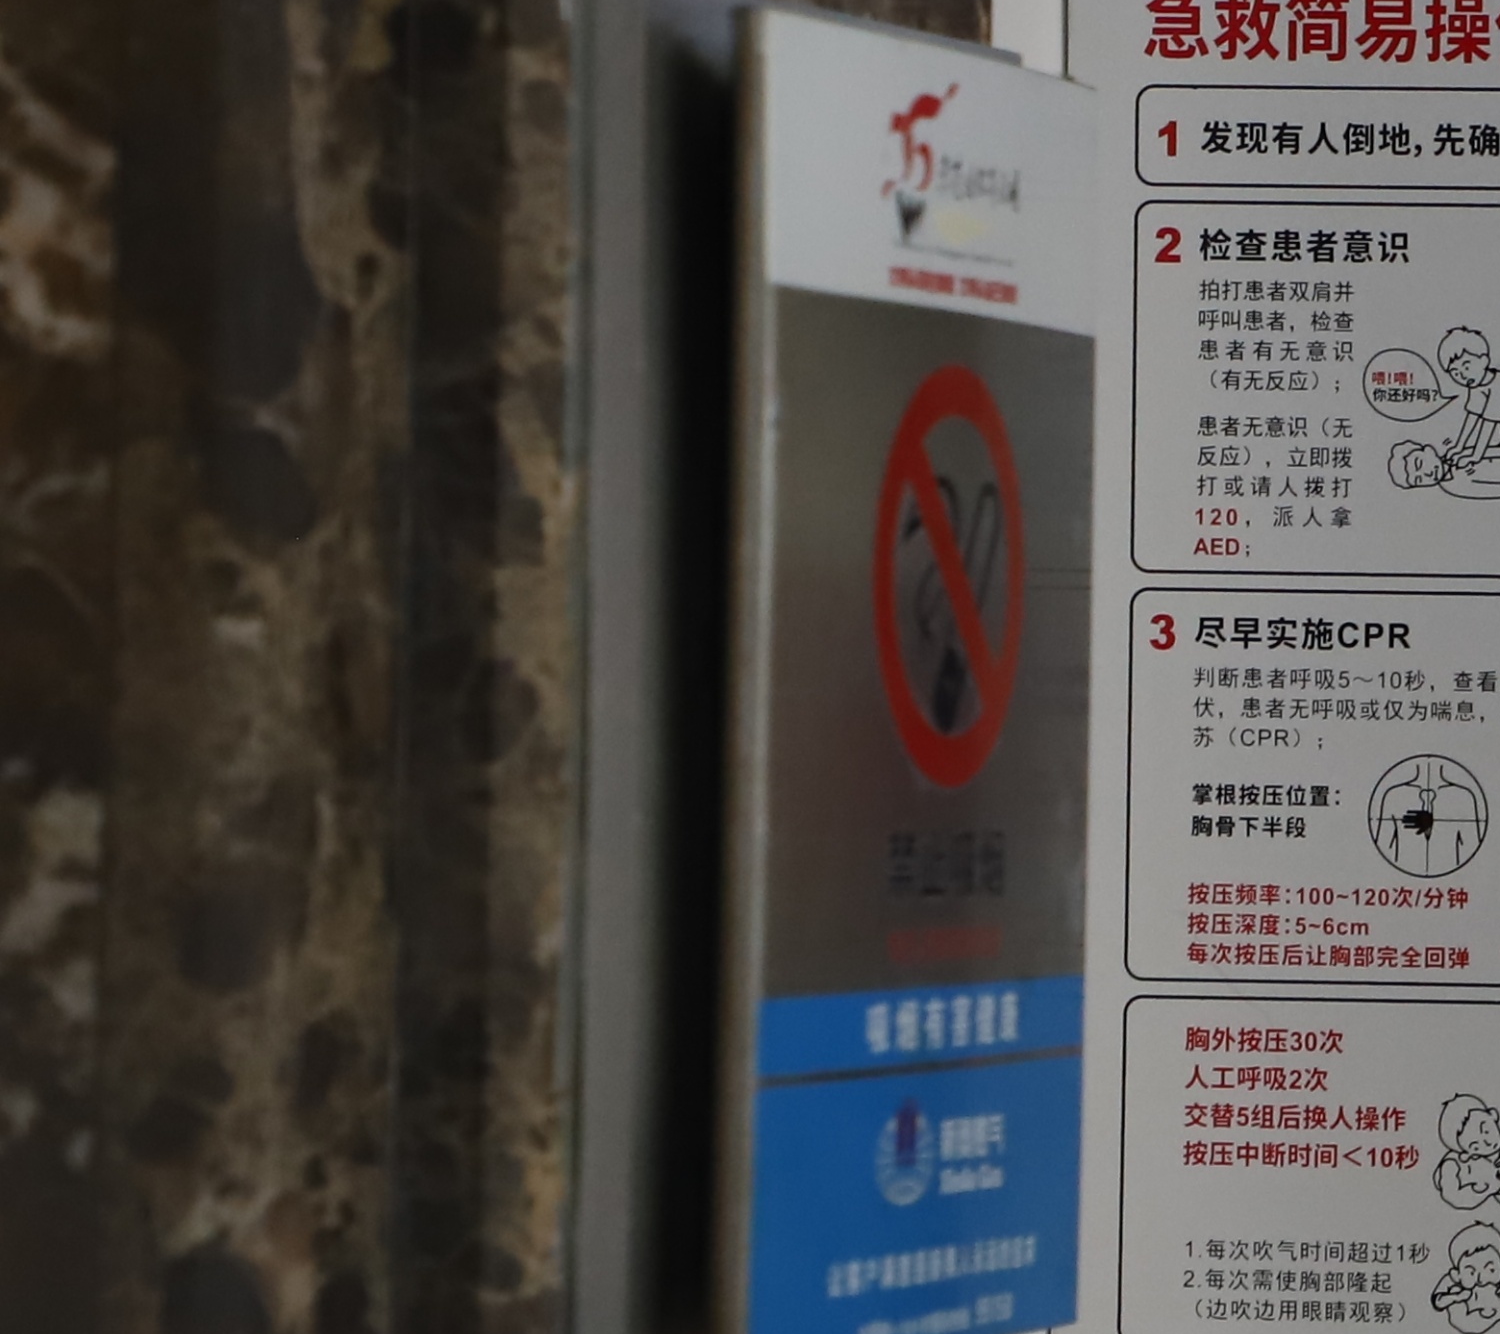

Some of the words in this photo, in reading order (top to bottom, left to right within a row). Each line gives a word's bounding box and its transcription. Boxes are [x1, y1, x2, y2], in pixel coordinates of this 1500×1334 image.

[1158, 121, 1177, 157] 1
[1155, 227, 1181, 263] 2
[1200, 228, 1409, 263] 检查患者意识
[1199, 279, 1354, 302] 拍打患者双肩并
[1198, 339, 1354, 362] 患者有无意识
[1197, 475, 1352, 498] 打或请人拨打
[1150, 614, 1176, 650] 3
[1195, 617, 1411, 651] 尽早实施CPR
[1191, 815, 1306, 838] 胸骨下半段
[1187, 942, 1470, 969] 每次按压后让胸部完全回弹
[1185, 1027, 1343, 1054] 胸外按压30次
[1185, 1064, 1328, 1092] 人工呼吸2次
[1184, 1102, 1406, 1132] 交替5组后换人操作
